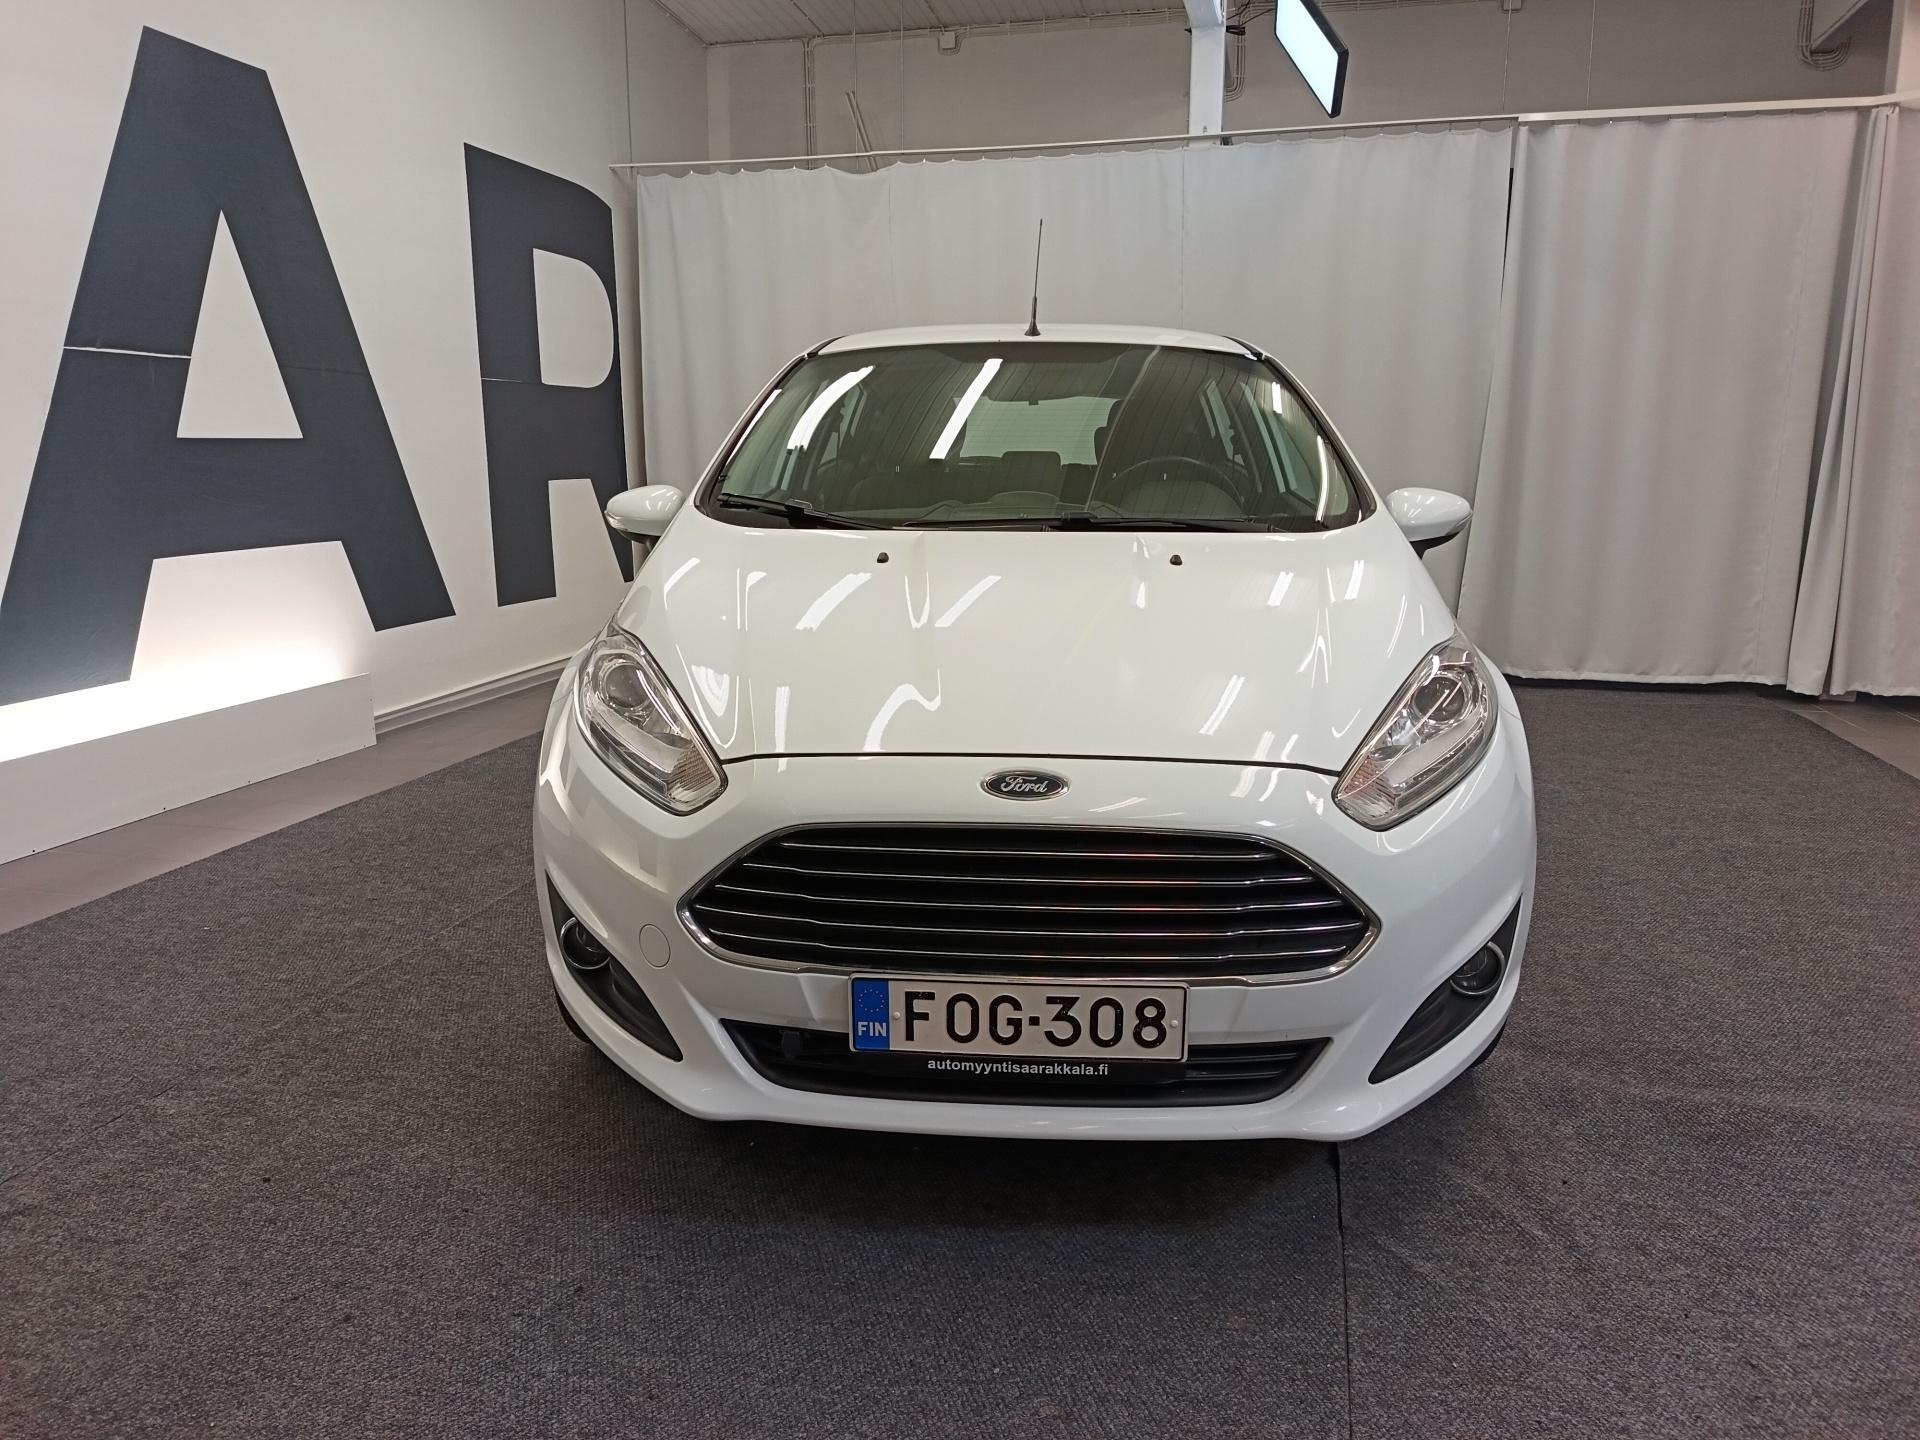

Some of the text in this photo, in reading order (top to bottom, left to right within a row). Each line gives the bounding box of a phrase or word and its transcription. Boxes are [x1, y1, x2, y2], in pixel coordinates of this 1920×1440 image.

[1000, 775, 1049, 793] Ford
[856, 990, 1168, 1049] FIN FOG-308
[927, 1058, 1109, 1076] automyyntisaarakkala.fi
